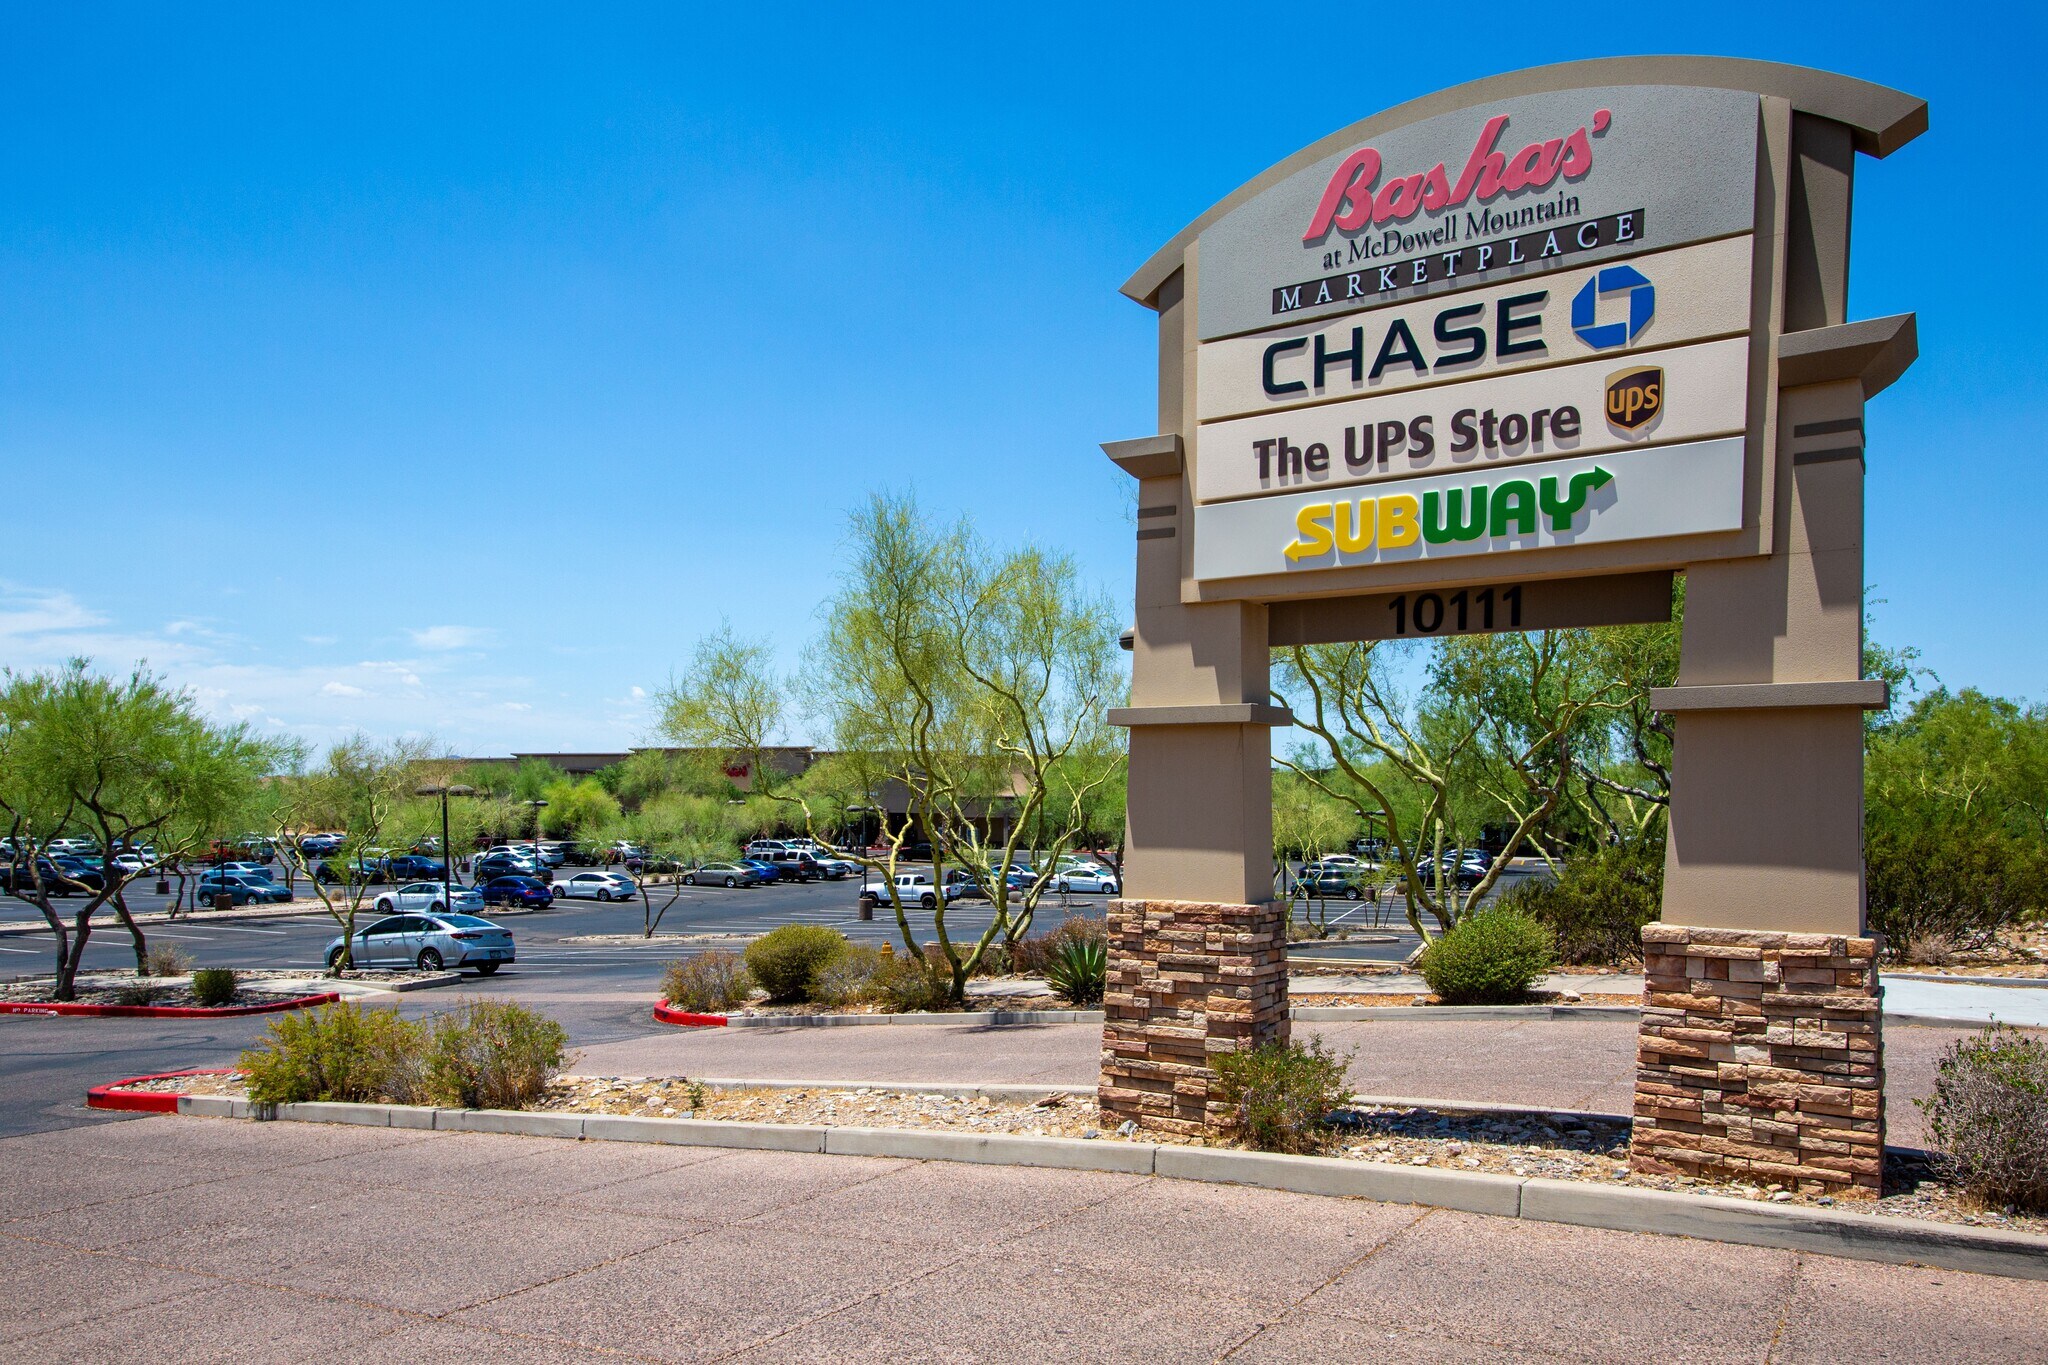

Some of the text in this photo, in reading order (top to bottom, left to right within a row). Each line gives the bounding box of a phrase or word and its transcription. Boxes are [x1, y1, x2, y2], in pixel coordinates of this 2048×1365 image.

[1303, 109, 1612, 240] Bashas'
[1279, 213, 1637, 312] MARKETPLACE
[1323, 191, 1580, 269] at McDowell Mountain
[1262, 289, 1549, 395] CHASE
[1252, 405, 1582, 480] The UPS Store
[1608, 384, 1659, 422] ups
[1283, 465, 1615, 563] SUBWAY
[1388, 584, 1523, 635] 10111
